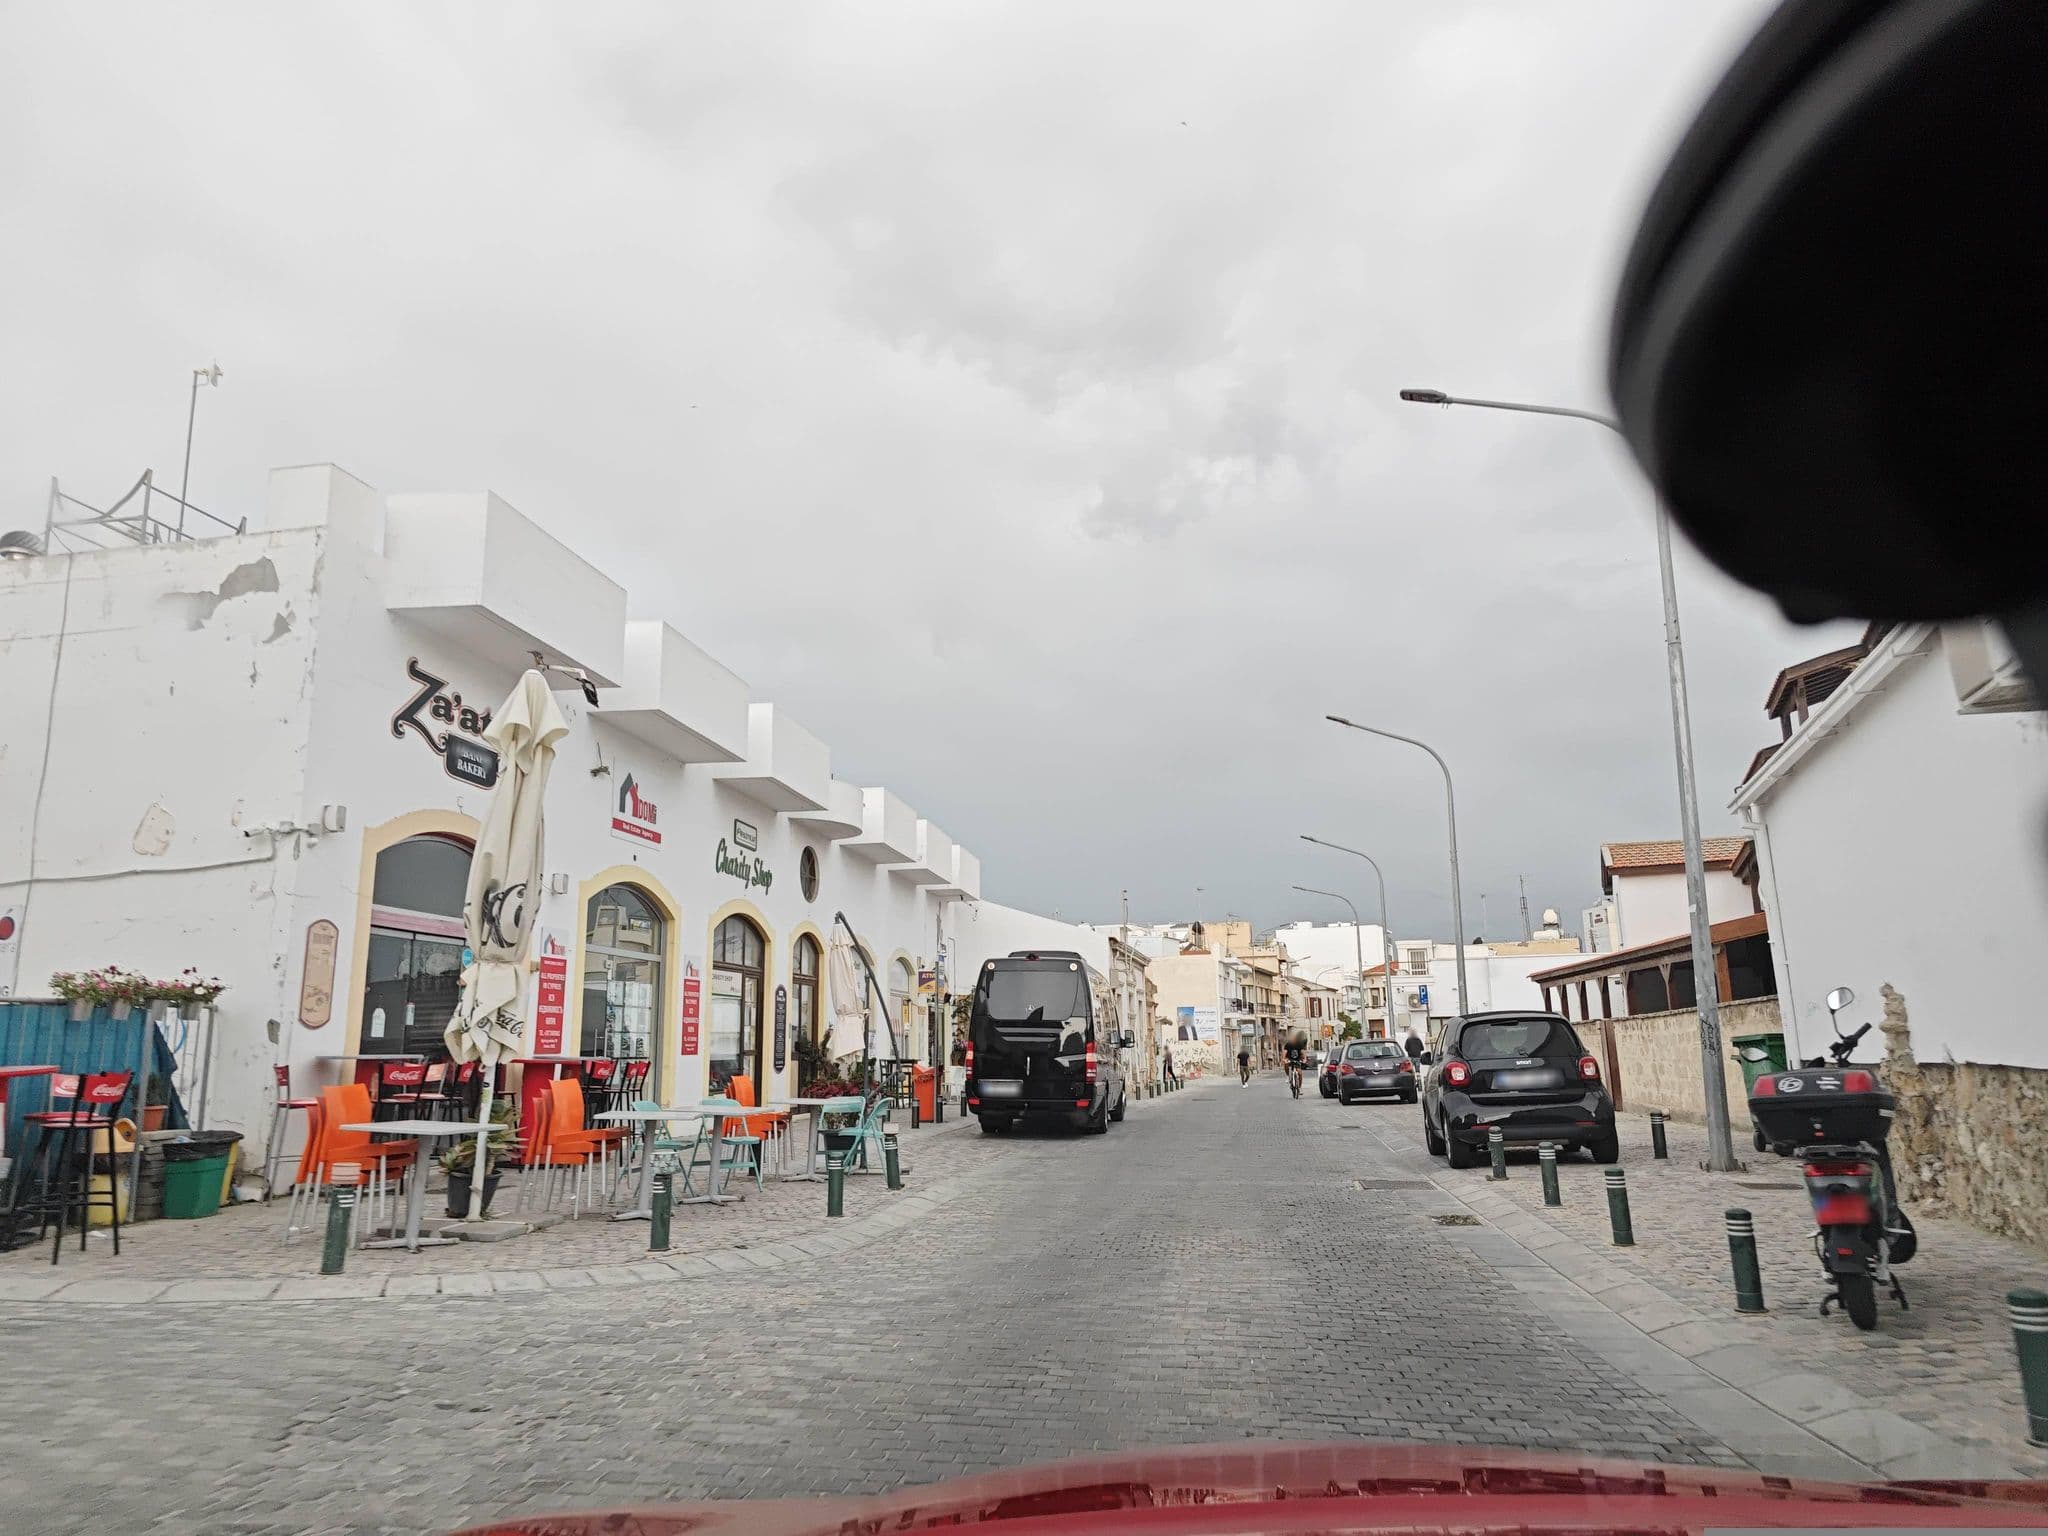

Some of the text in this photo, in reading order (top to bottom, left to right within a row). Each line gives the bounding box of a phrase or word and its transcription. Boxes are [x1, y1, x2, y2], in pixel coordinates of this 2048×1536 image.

[715, 837, 773, 895] Charity Shop
[921, 971, 936, 980] ATM
[389, 1070, 422, 1081] Coca-Cola
